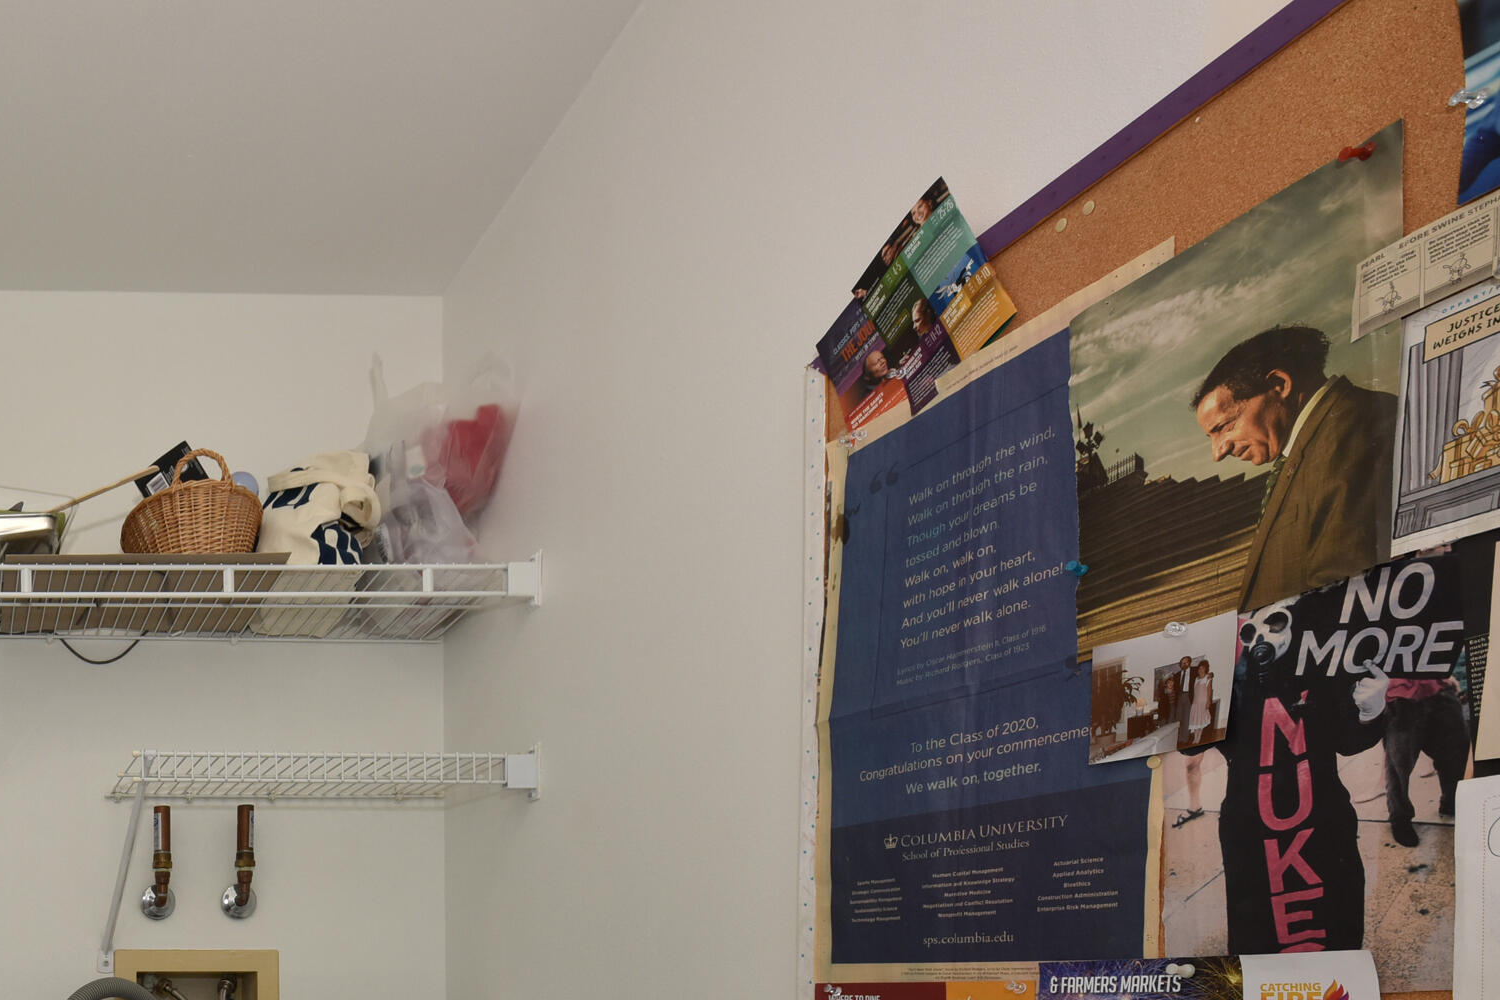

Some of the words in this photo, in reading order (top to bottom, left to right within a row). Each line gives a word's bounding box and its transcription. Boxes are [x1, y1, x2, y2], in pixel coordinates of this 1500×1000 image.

[1431, 209, 1465, 233] SWINE
[1446, 303, 1500, 333] JUSTICE
[1432, 324, 1483, 350] WEIGHS
[909, 486, 933, 505] Walk
[936, 480, 949, 493] on
[952, 455, 991, 485] through
[995, 445, 1015, 461] the
[1020, 426, 1055, 449] wind,
[907, 505, 932, 526] Walk
[936, 501, 948, 514] on
[952, 478, 990, 506] through
[995, 468, 1014, 483] the
[1019, 455, 1048, 473] rain,
[907, 522, 945, 547] Though
[949, 511, 969, 529] your
[973, 489, 1015, 516] dreams
[1019, 481, 1037, 496] be
[905, 542, 939, 568] tossed
[942, 535, 961, 552] and
[905, 570, 930, 588] Walk
[933, 565, 949, 576] on,
[952, 551, 973, 568] walk
[977, 544, 997, 557] on,
[901, 613, 923, 629] And
[927, 601, 955, 623] you'll
[958, 589, 989, 608] never
[993, 578, 1019, 596] walk
[1023, 562, 1063, 586] alone!
[903, 592, 925, 608] with
[929, 580, 956, 600] hope
[958, 576, 966, 587] in
[969, 565, 997, 584] your
[1000, 550, 1036, 571] heart,
[1339, 562, 1435, 624] NO
[901, 632, 928, 649] You'll
[932, 622, 960, 638] never
[964, 610, 992, 628] walk
[996, 599, 1031, 618] alone.
[1295, 621, 1464, 677] MORE
[910, 742, 922, 754] To
[926, 736, 946, 750] the
[950, 731, 983, 746] Class
[987, 725, 1000, 739] of
[1002, 716, 1039, 735] 2020,
[860, 757, 943, 783] Congratulations
[946, 753, 963, 765] on
[967, 746, 994, 763] your
[906, 782, 923, 795] We
[927, 776, 957, 791] walk
[962, 774, 980, 786] on,
[984, 762, 1041, 783] together.
[901, 828, 975, 847] COLUMBIA
[980, 814, 1069, 838] UNIVERSITY
[901, 849, 928, 862] School
[931, 848, 940, 858] of
[943, 841, 994, 857] Professional
[996, 838, 1030, 849] Studies
[923, 931, 1014, 948] sps.columbia.edu
[1050, 978, 1058, 993] &
[1061, 976, 1117, 994] FARMERS
[1120, 974, 1182, 993] MARKETS
[1260, 982, 1321, 992] CATCHING
